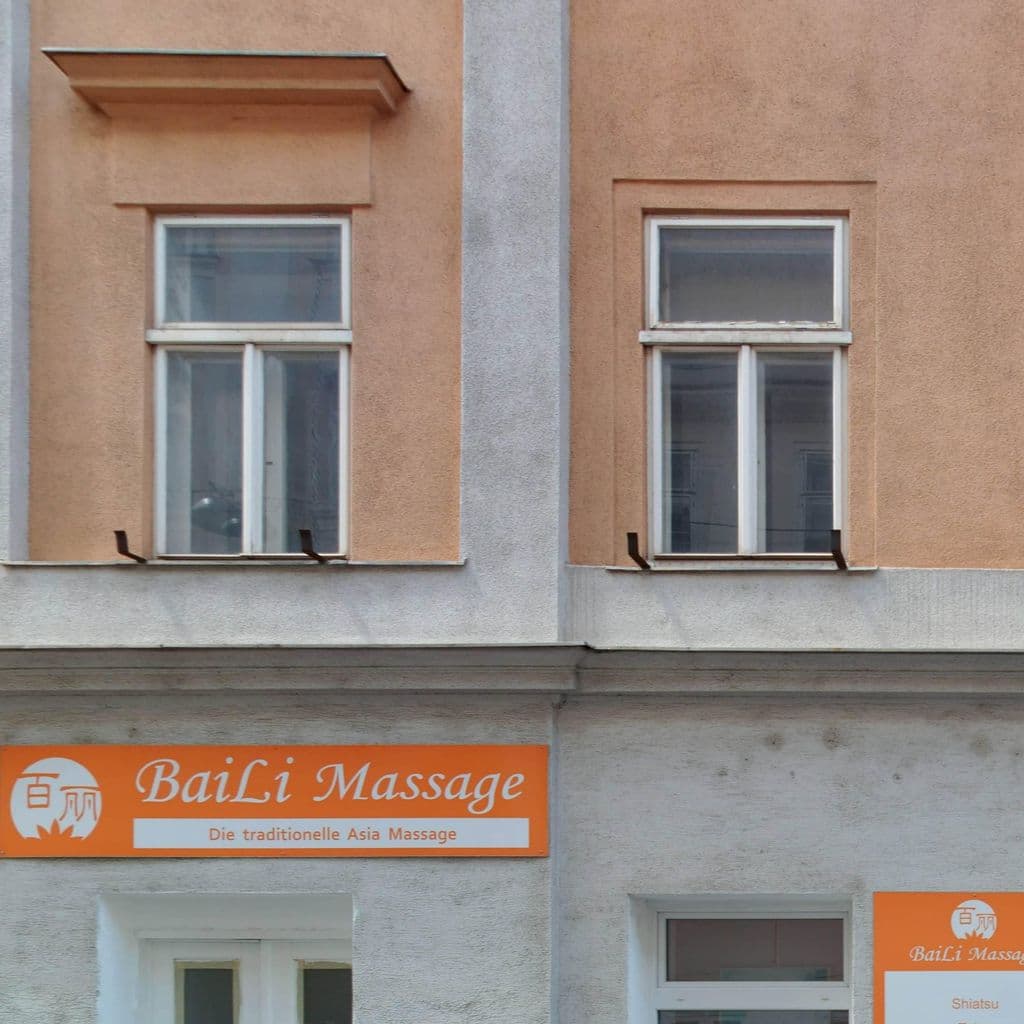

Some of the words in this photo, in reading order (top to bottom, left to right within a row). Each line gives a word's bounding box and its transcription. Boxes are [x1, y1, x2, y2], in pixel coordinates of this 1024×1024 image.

[135, 756, 294, 804] BaiLi
[313, 762, 525, 815] Massage
[208, 826, 236, 841] Die
[241, 826, 341, 841] traditionelle
[346, 826, 381, 841] Asia
[388, 826, 457, 845] Massage
[909, 945, 962, 962] BaiLi
[952, 998, 999, 1010] Shiatsu
